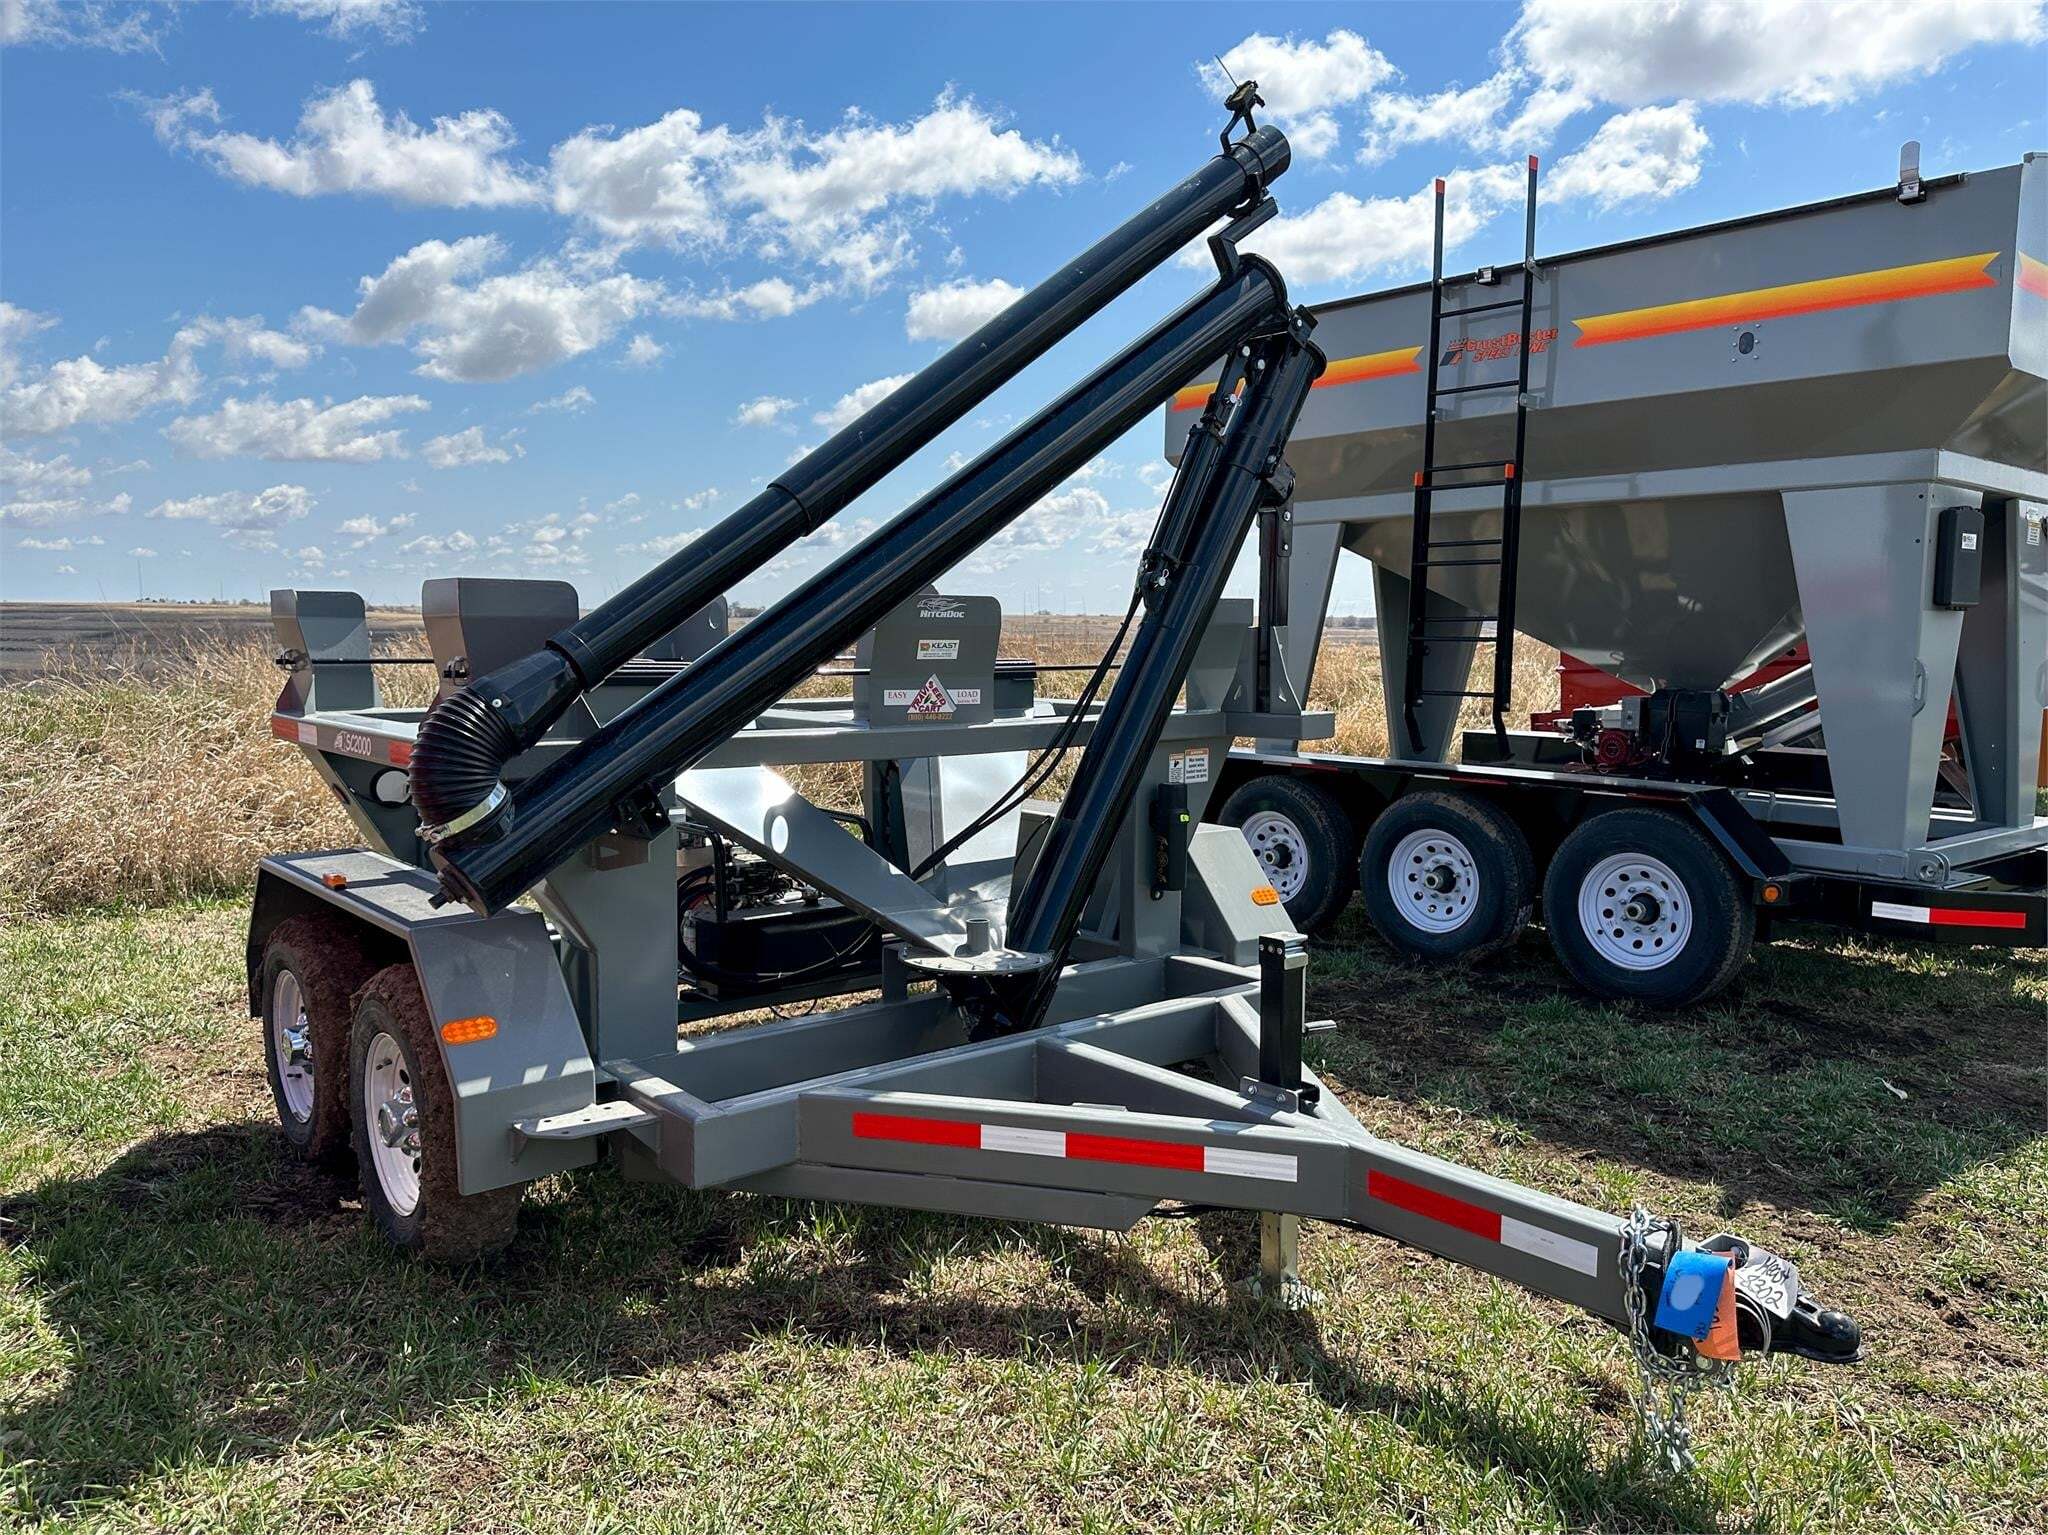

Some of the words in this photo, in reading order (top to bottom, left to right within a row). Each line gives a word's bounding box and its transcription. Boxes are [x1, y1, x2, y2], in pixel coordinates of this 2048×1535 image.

[1466, 327, 1559, 351] CrustBter
[888, 691, 908, 699] EASY
[957, 690, 978, 699] LOAD
[346, 733, 372, 756] SC2000
